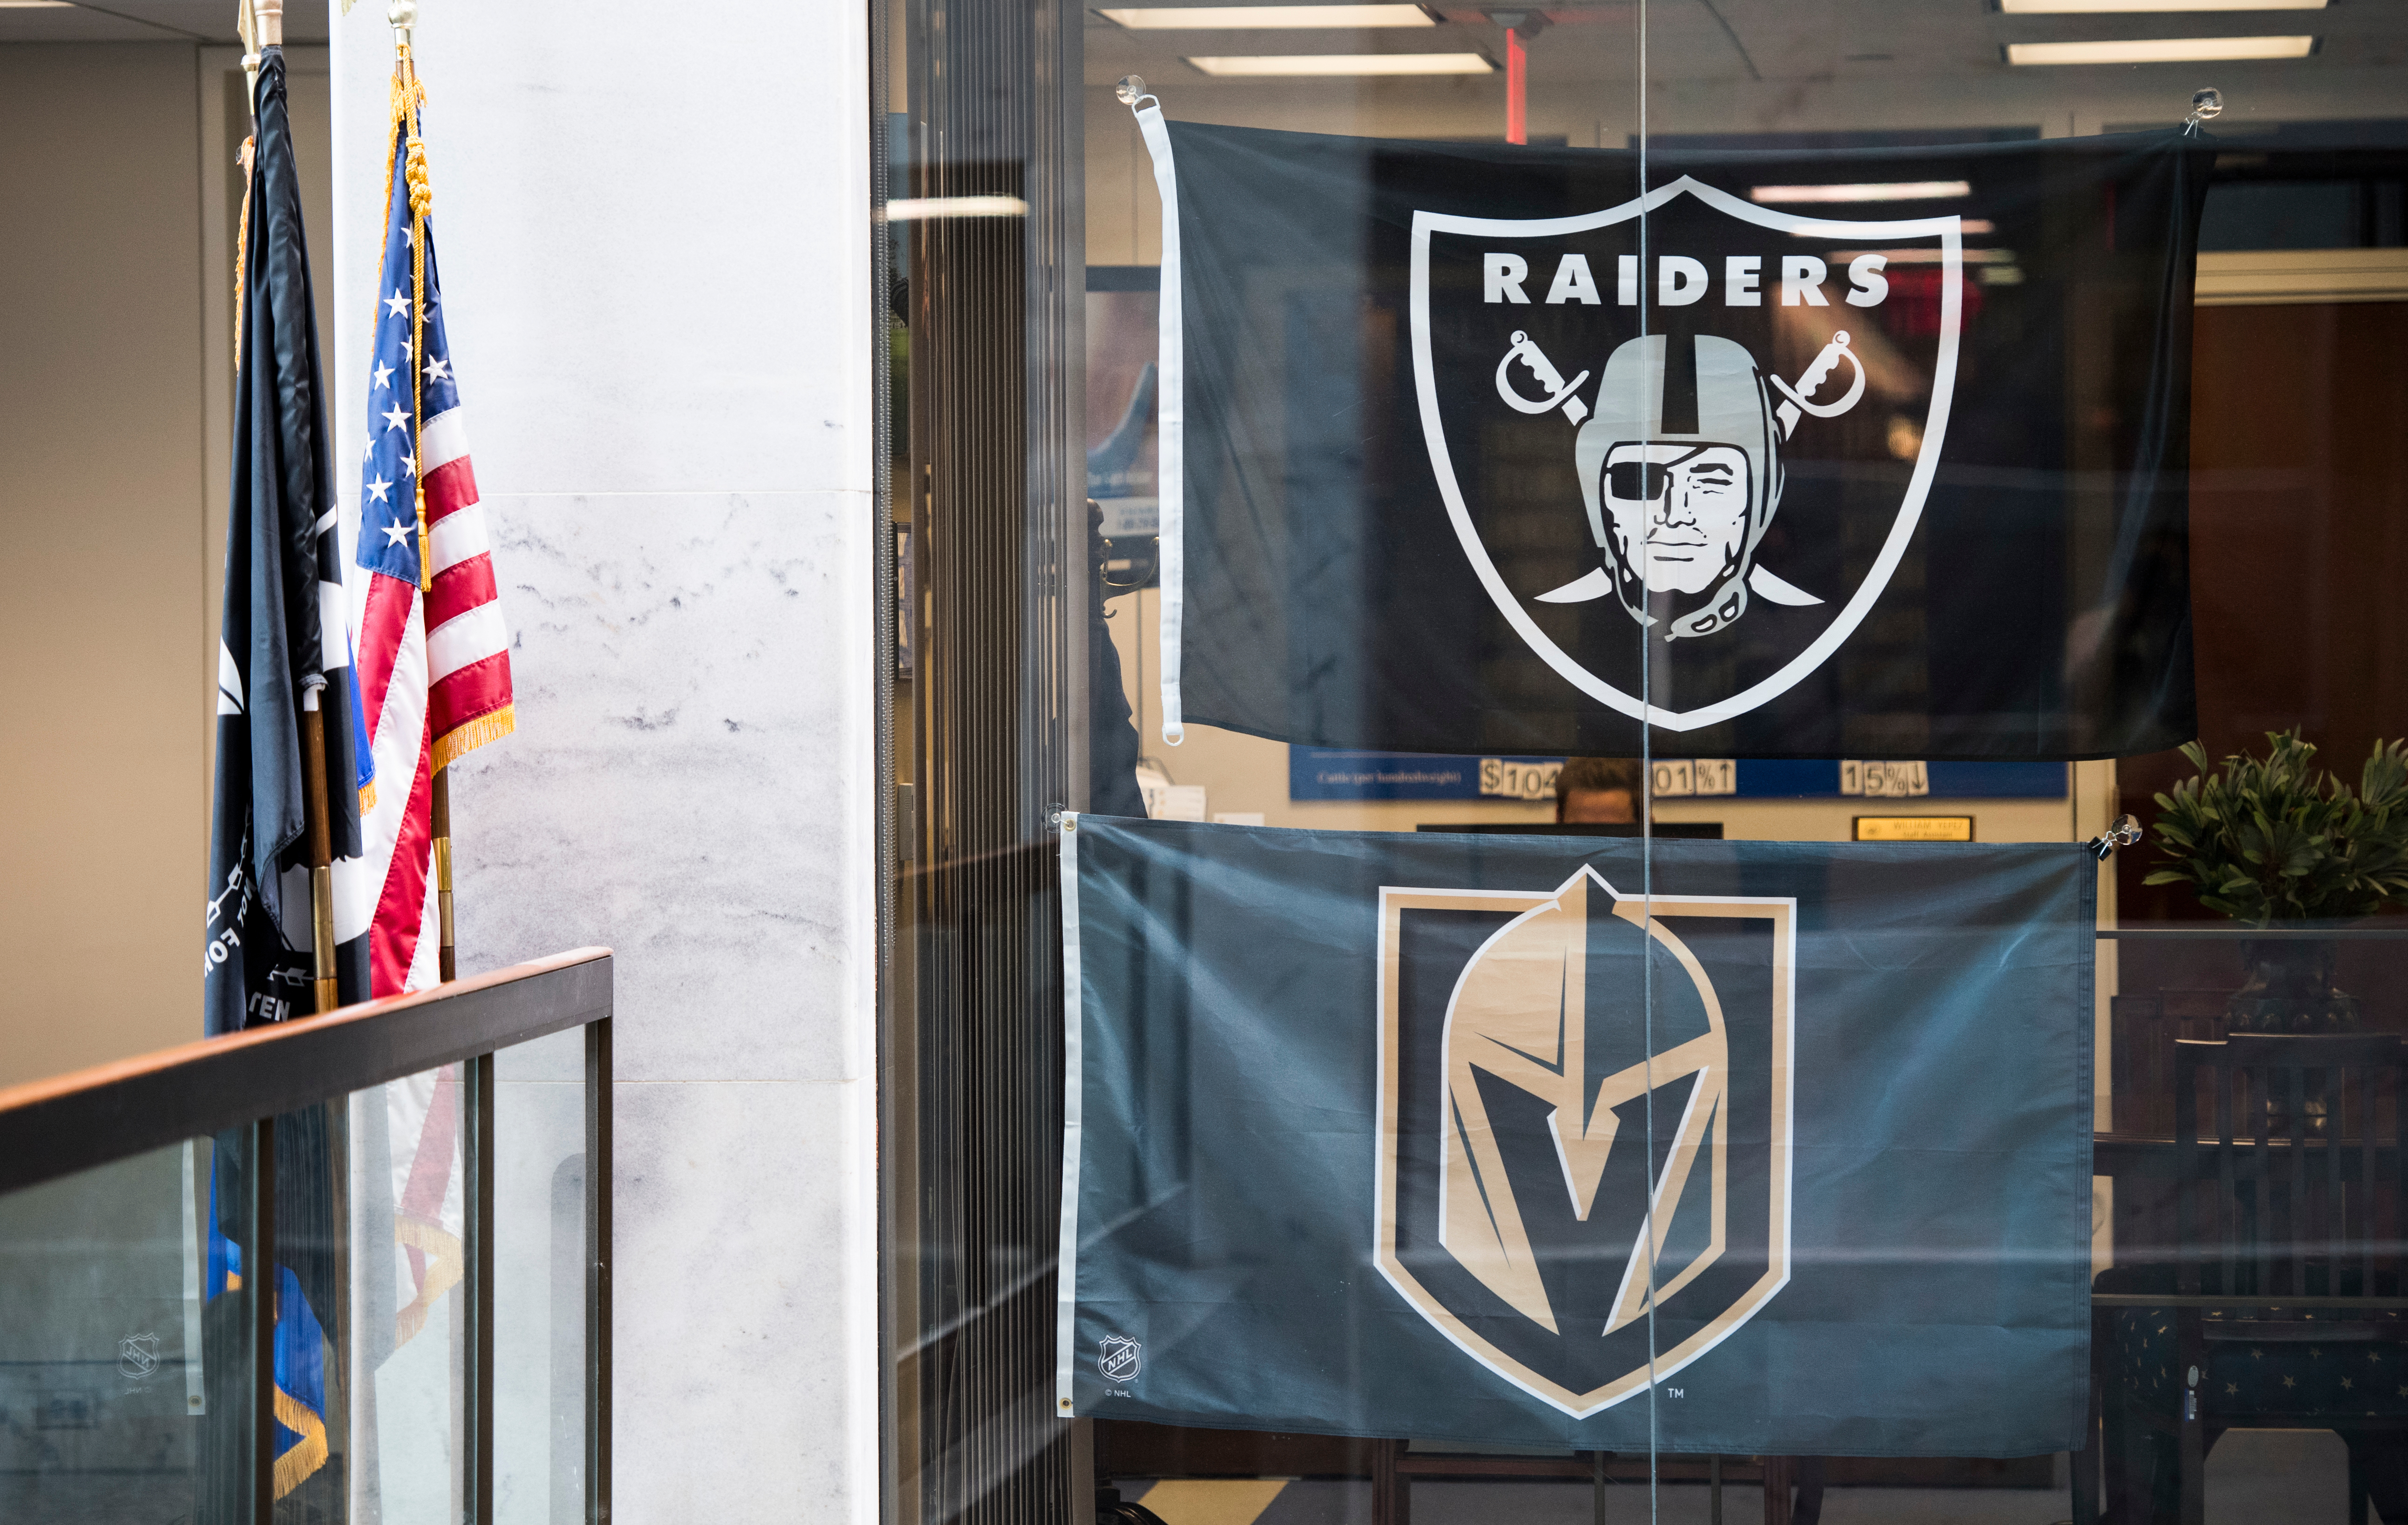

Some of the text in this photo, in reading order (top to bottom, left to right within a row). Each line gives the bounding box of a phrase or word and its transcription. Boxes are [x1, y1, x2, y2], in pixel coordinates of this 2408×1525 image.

[1484, 253, 1888, 307] RAIDERS
[1108, 1348, 1132, 1371] NHL
[1668, 1388, 1684, 1398] TM
